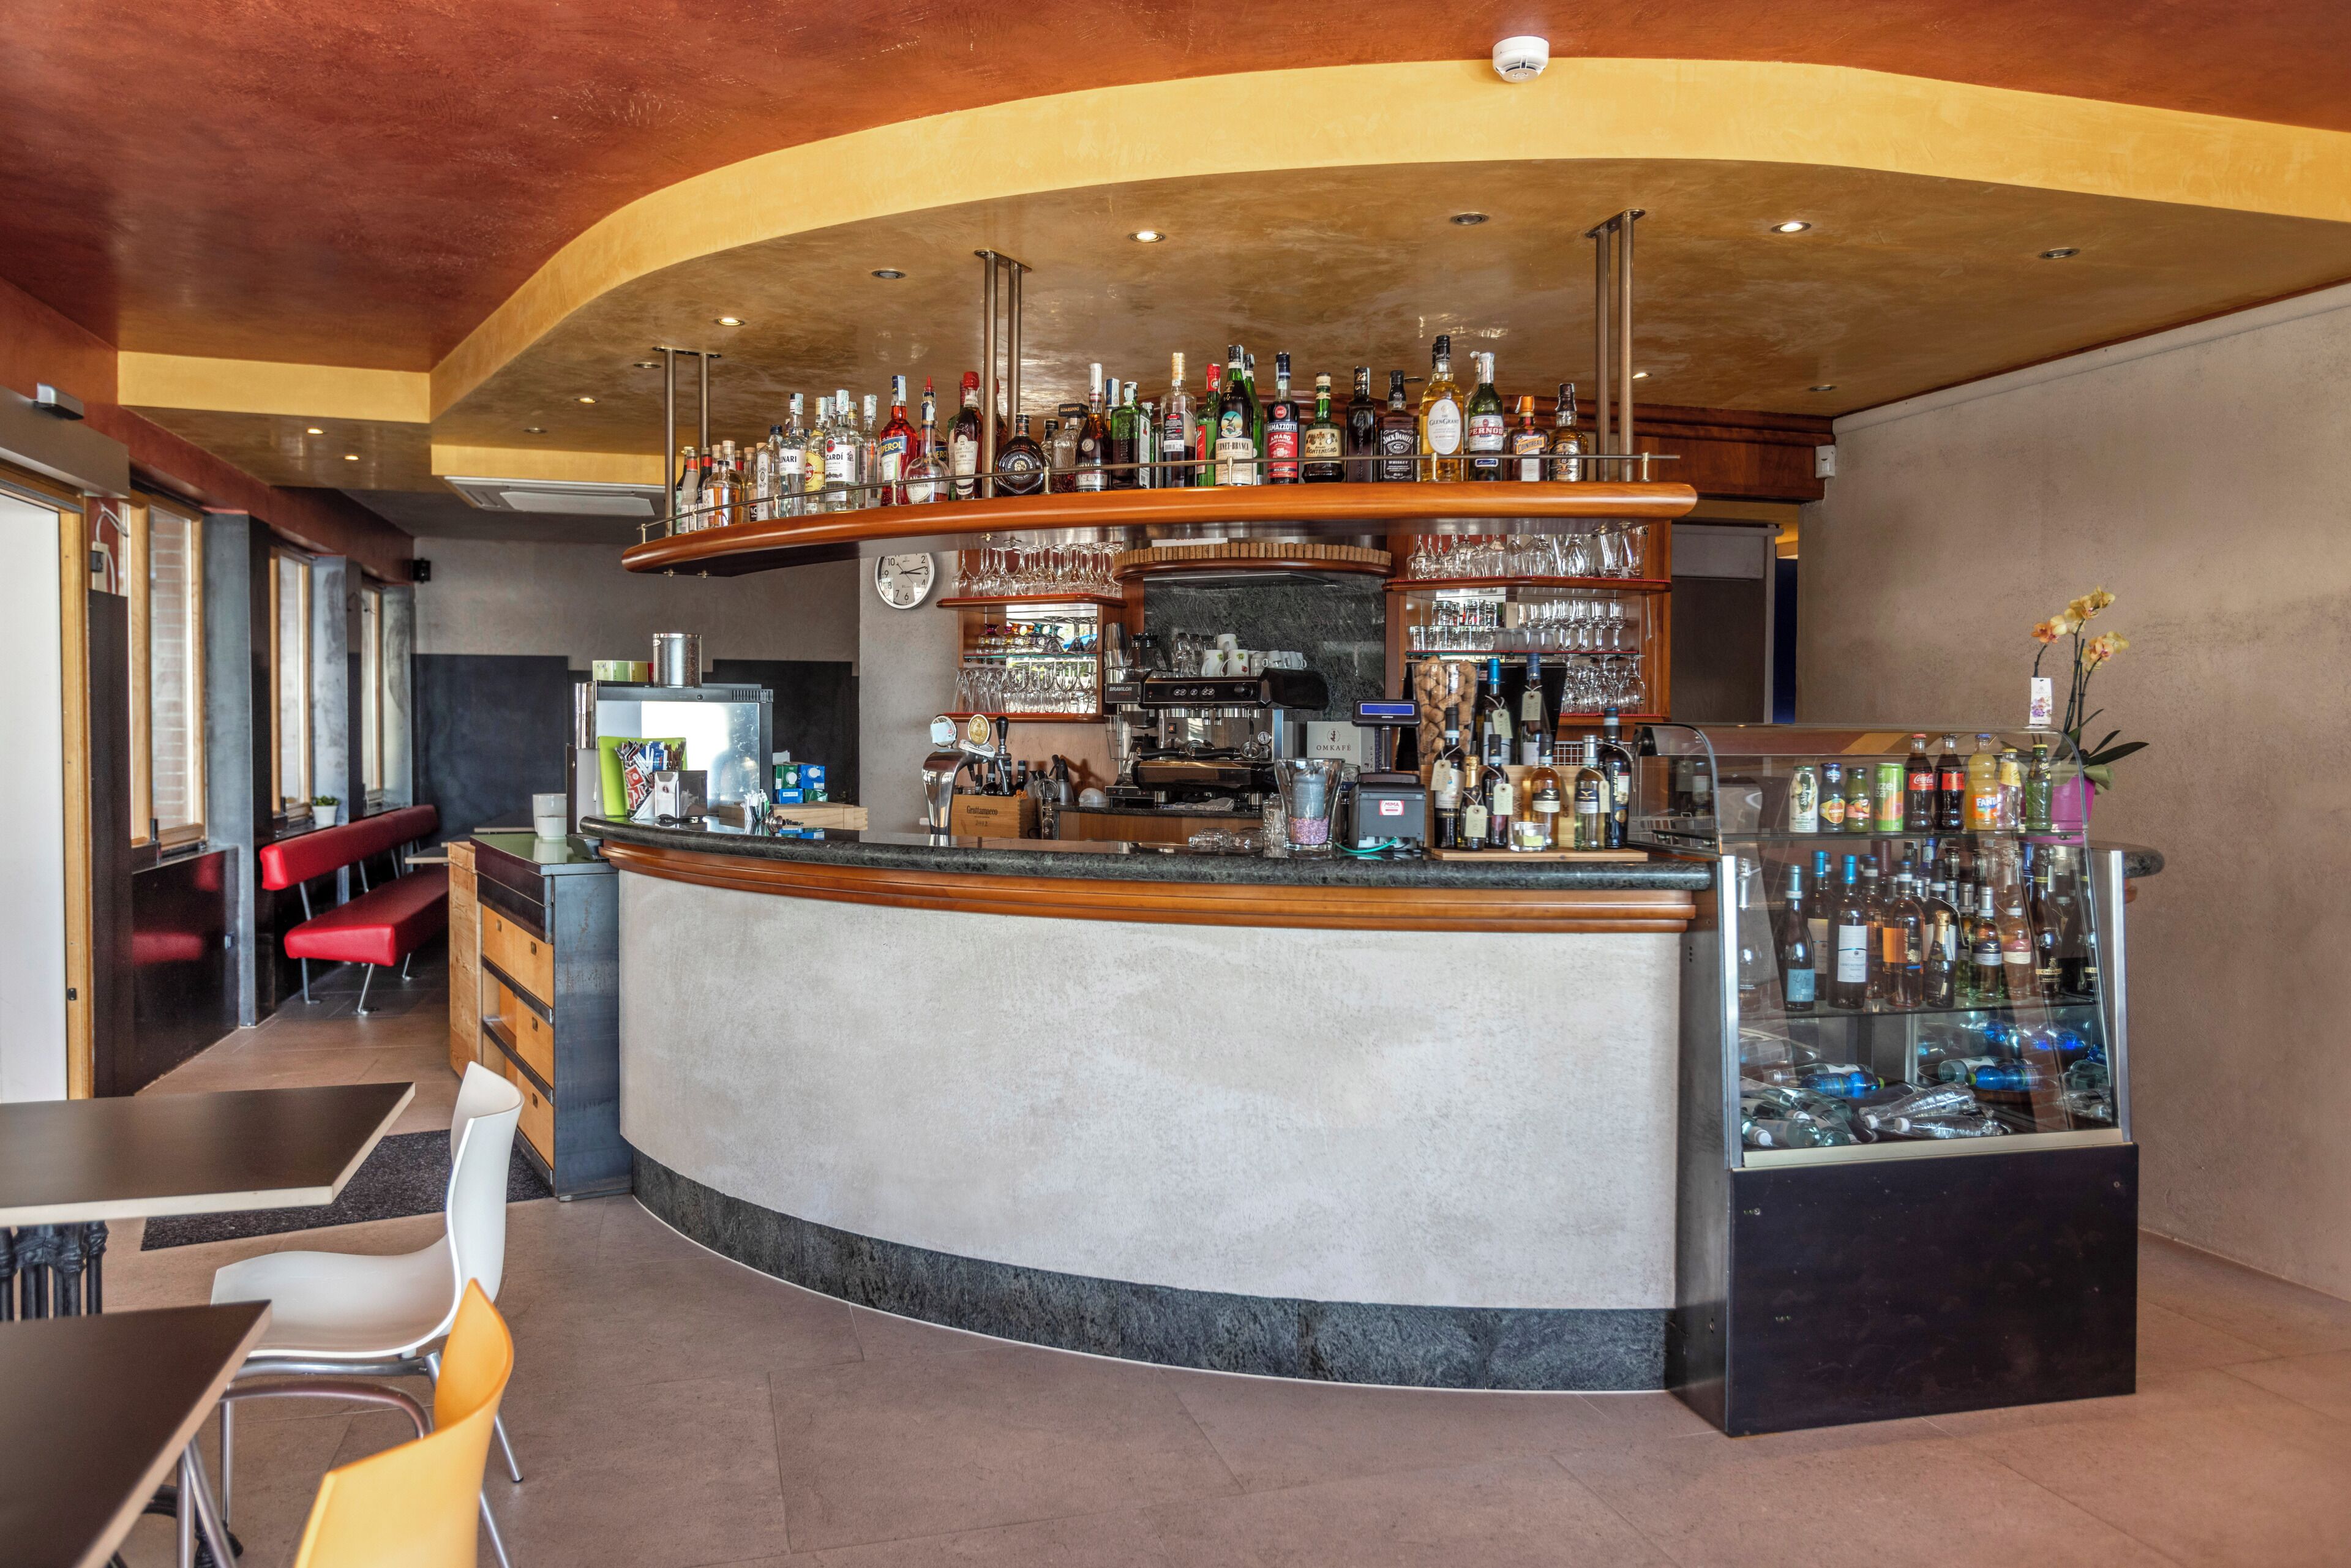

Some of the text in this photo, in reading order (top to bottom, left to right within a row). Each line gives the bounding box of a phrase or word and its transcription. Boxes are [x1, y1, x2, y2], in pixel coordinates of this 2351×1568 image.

[1382, 434, 1395, 445] JACK
[1518, 440, 1542, 453] COINTREAU
[924, 566, 929, 575] 3
[1976, 797, 1996, 807] FANT
[967, 805, 998, 816] Grattamacco
